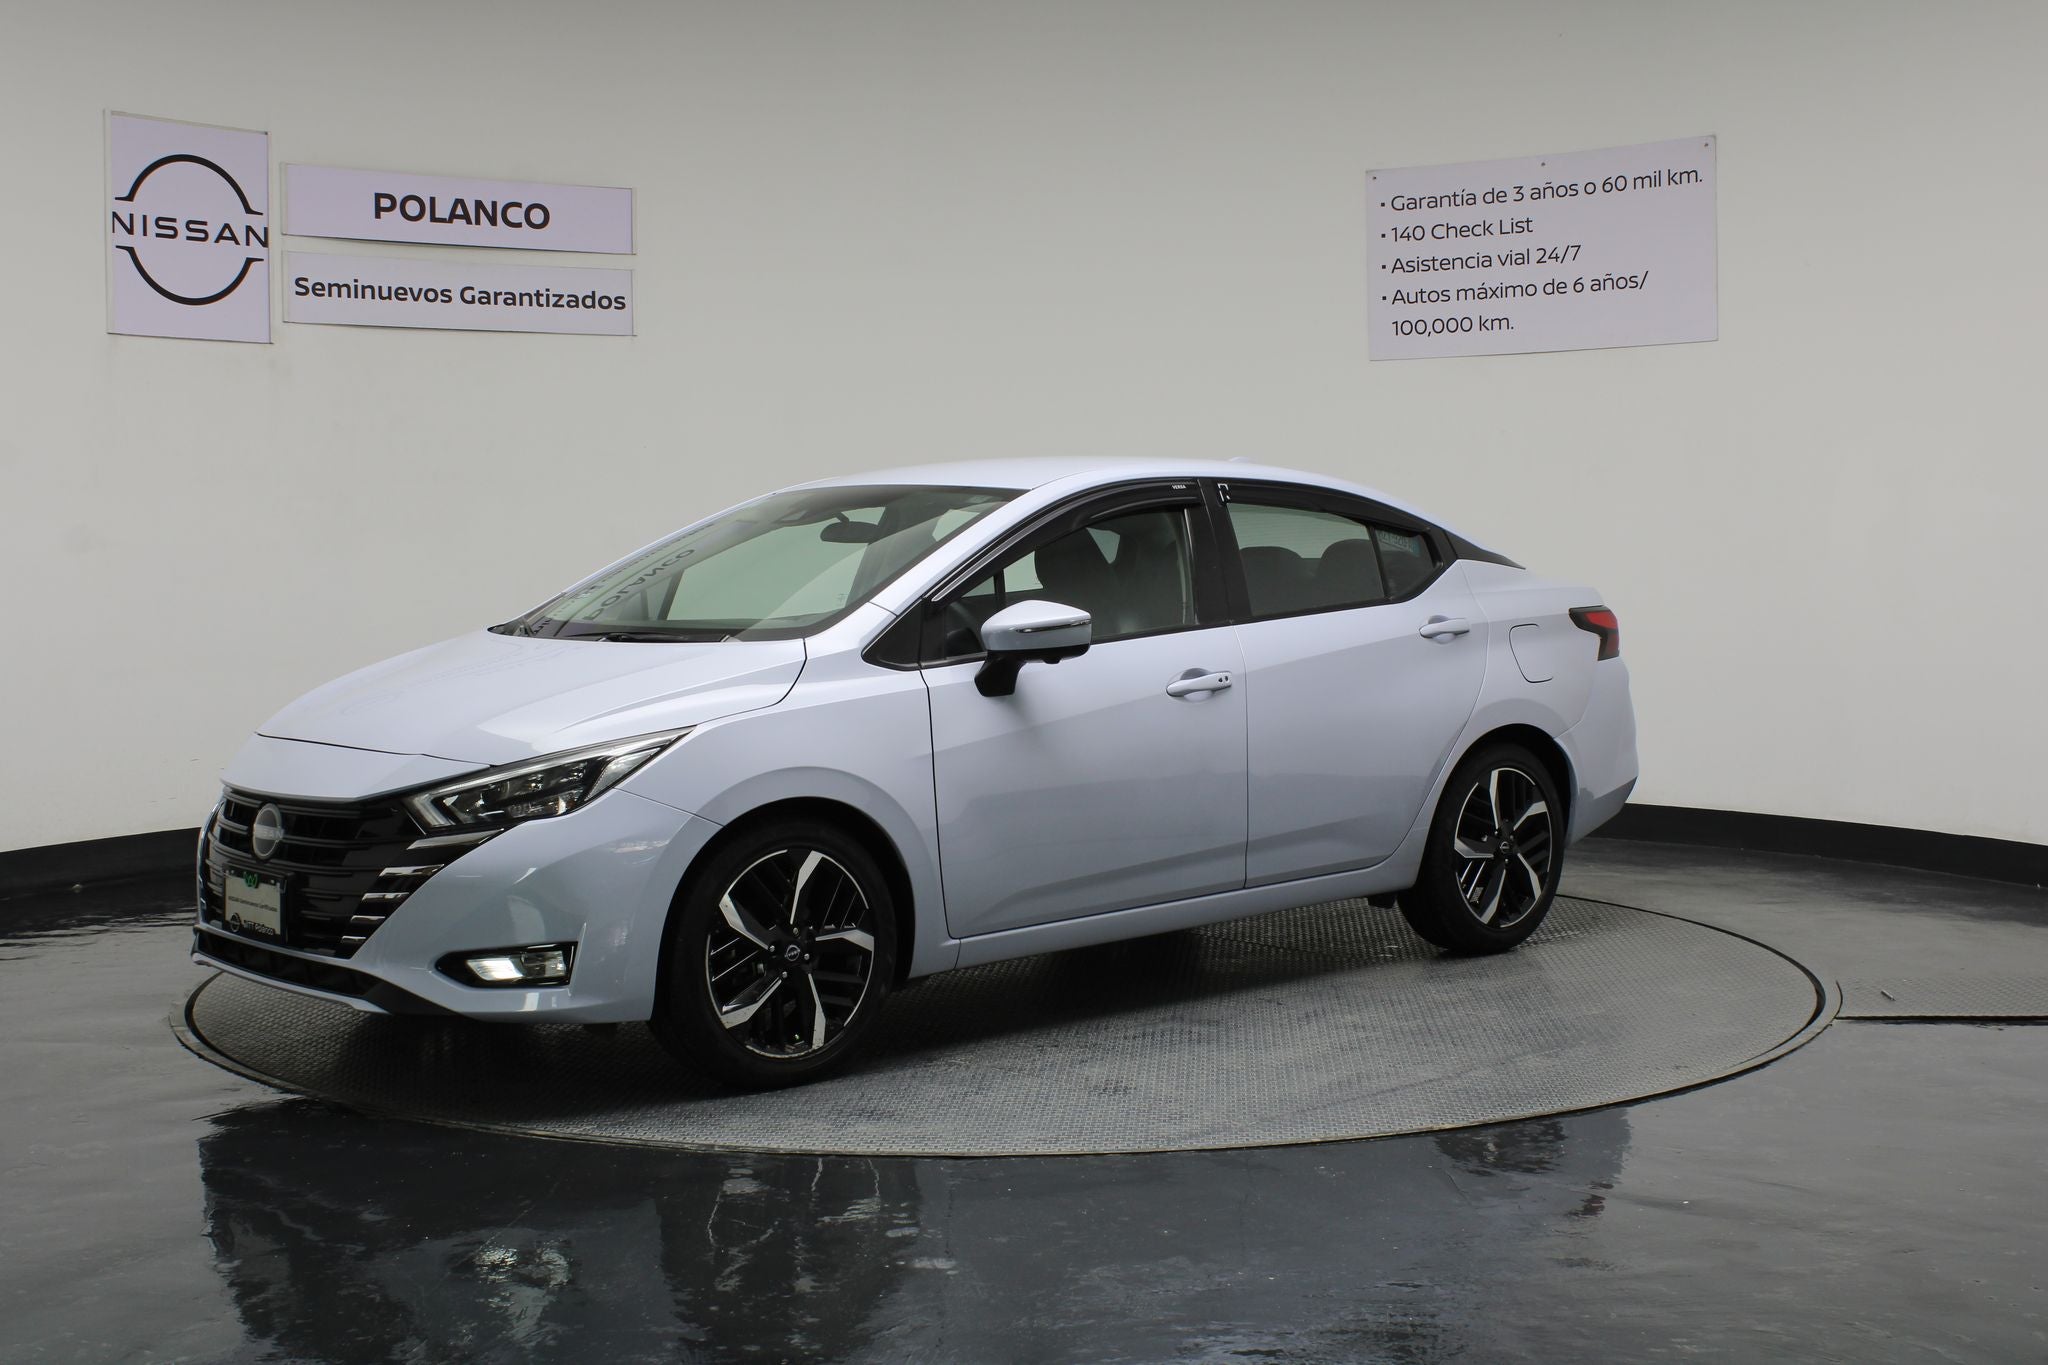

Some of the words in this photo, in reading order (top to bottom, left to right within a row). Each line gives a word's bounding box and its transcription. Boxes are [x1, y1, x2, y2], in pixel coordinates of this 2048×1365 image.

[1390, 188, 1477, 212] Garantía
[1482, 187, 1508, 205] de
[1512, 185, 1525, 203] 3
[1529, 181, 1579, 201] años
[1583, 181, 1597, 196] o
[1601, 174, 1628, 194] 60
[1633, 169, 1662, 191] mil
[1667, 168, 1703, 187] km.
[373, 192, 551, 230] POLANCO
[111, 210, 269, 249] NISSAN
[1391, 225, 1426, 243] 140
[1430, 219, 1495, 240] Check
[1499, 217, 1534, 236] List
[1390, 254, 1493, 274] Asistencia
[1496, 247, 1530, 267] vial
[1535, 244, 1582, 265] 24/7
[294, 276, 453, 304] Seminuevos
[459, 285, 626, 311] Garantizados
[1391, 289, 1451, 306] Autos
[1456, 281, 1538, 302] máximo
[1542, 277, 1568, 296] de
[1572, 276, 1585, 294] 6
[1590, 270, 1649, 292] años/
[1391, 316, 1474, 338] 100,000
[1478, 314, 1514, 332] km.
